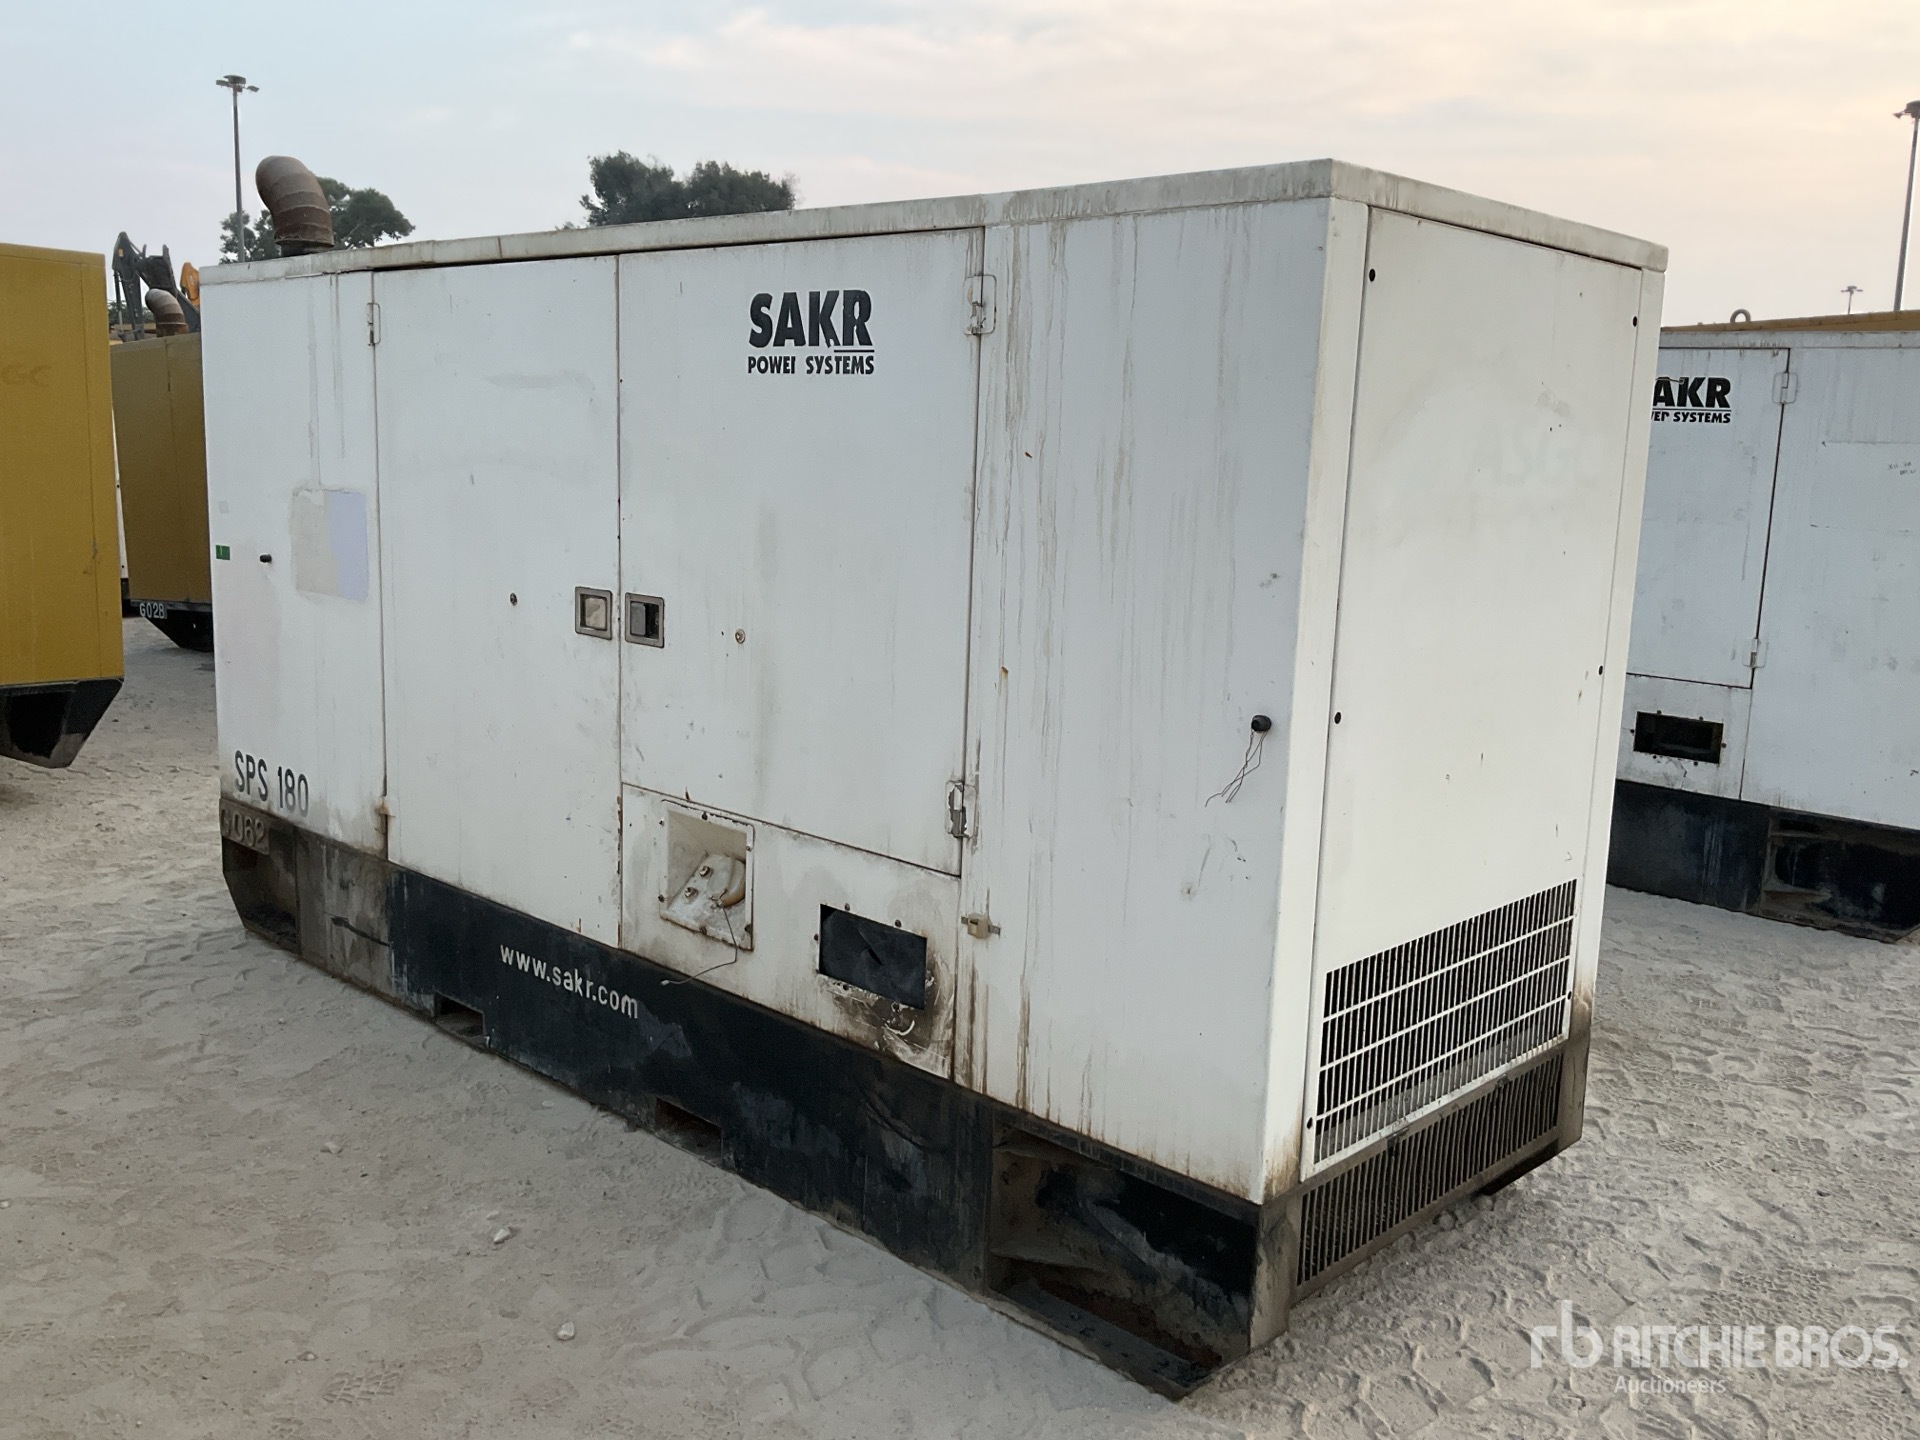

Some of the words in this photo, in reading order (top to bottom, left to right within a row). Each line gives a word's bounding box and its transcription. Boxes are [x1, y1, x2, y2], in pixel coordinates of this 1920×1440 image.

[749, 289, 873, 348] SAKR
[805, 356, 875, 375] SYSTEMS
[1652, 376, 1731, 408] AKR
[1673, 411, 1731, 423] SYSTEMS
[234, 750, 269, 802] SPS
[277, 766, 309, 818] 180
[500, 944, 638, 1019] www.sakr.com
